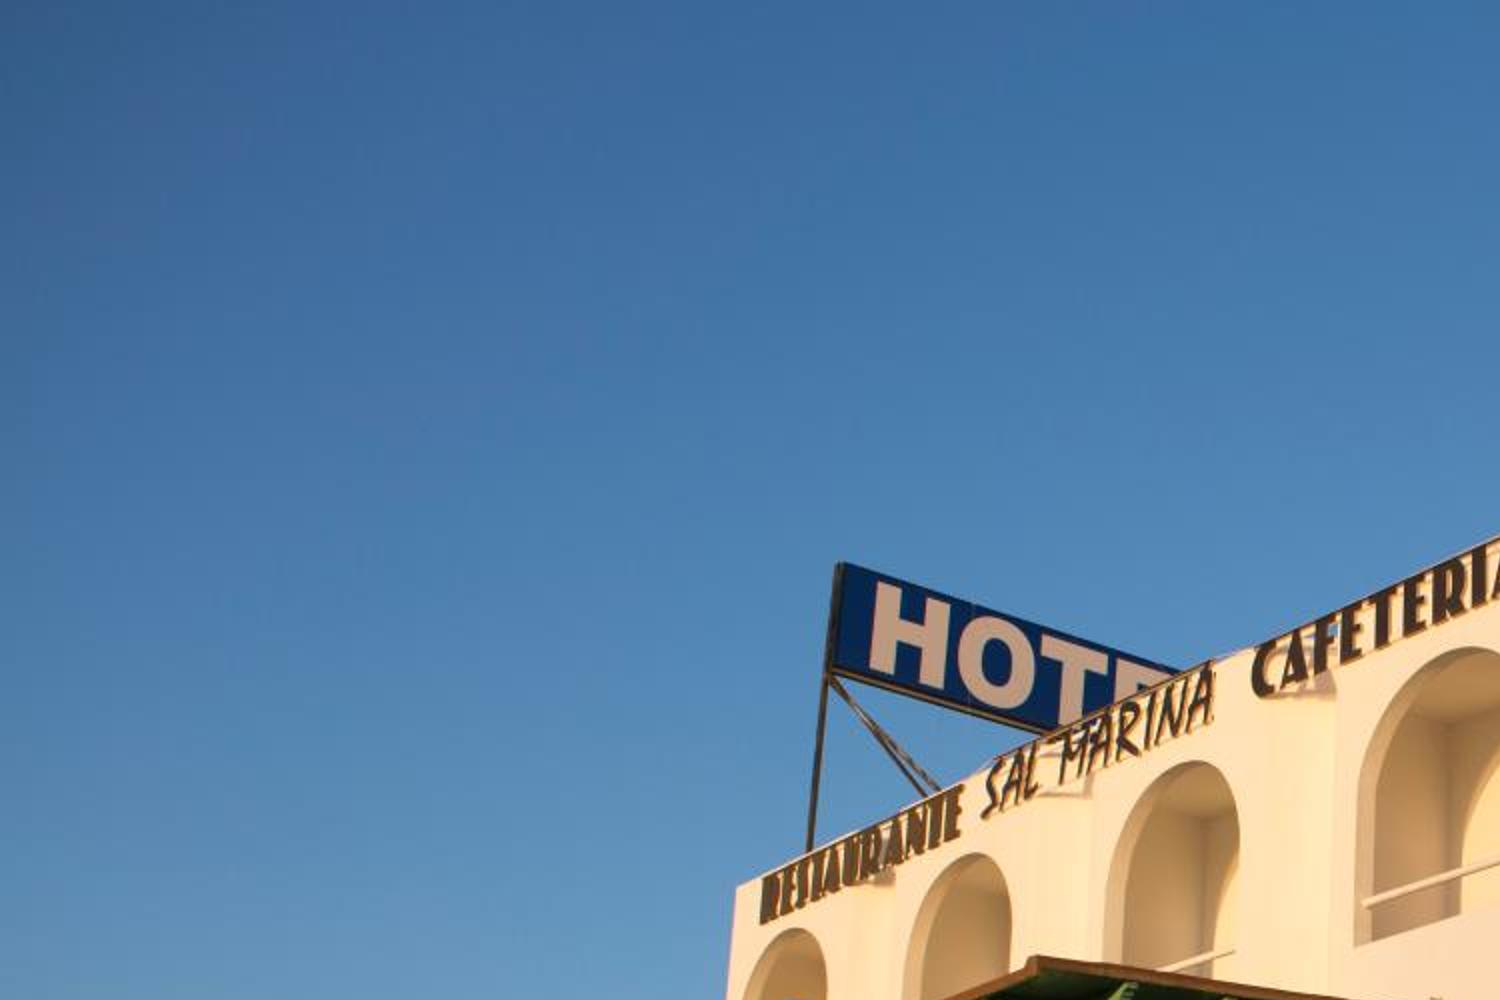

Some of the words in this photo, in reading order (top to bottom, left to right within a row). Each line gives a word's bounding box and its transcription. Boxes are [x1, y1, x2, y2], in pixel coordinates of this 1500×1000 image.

[980, 738, 1042, 821] SAL
[1053, 659, 1216, 786] MARINA
[759, 783, 966, 926] RESTAURANTE
